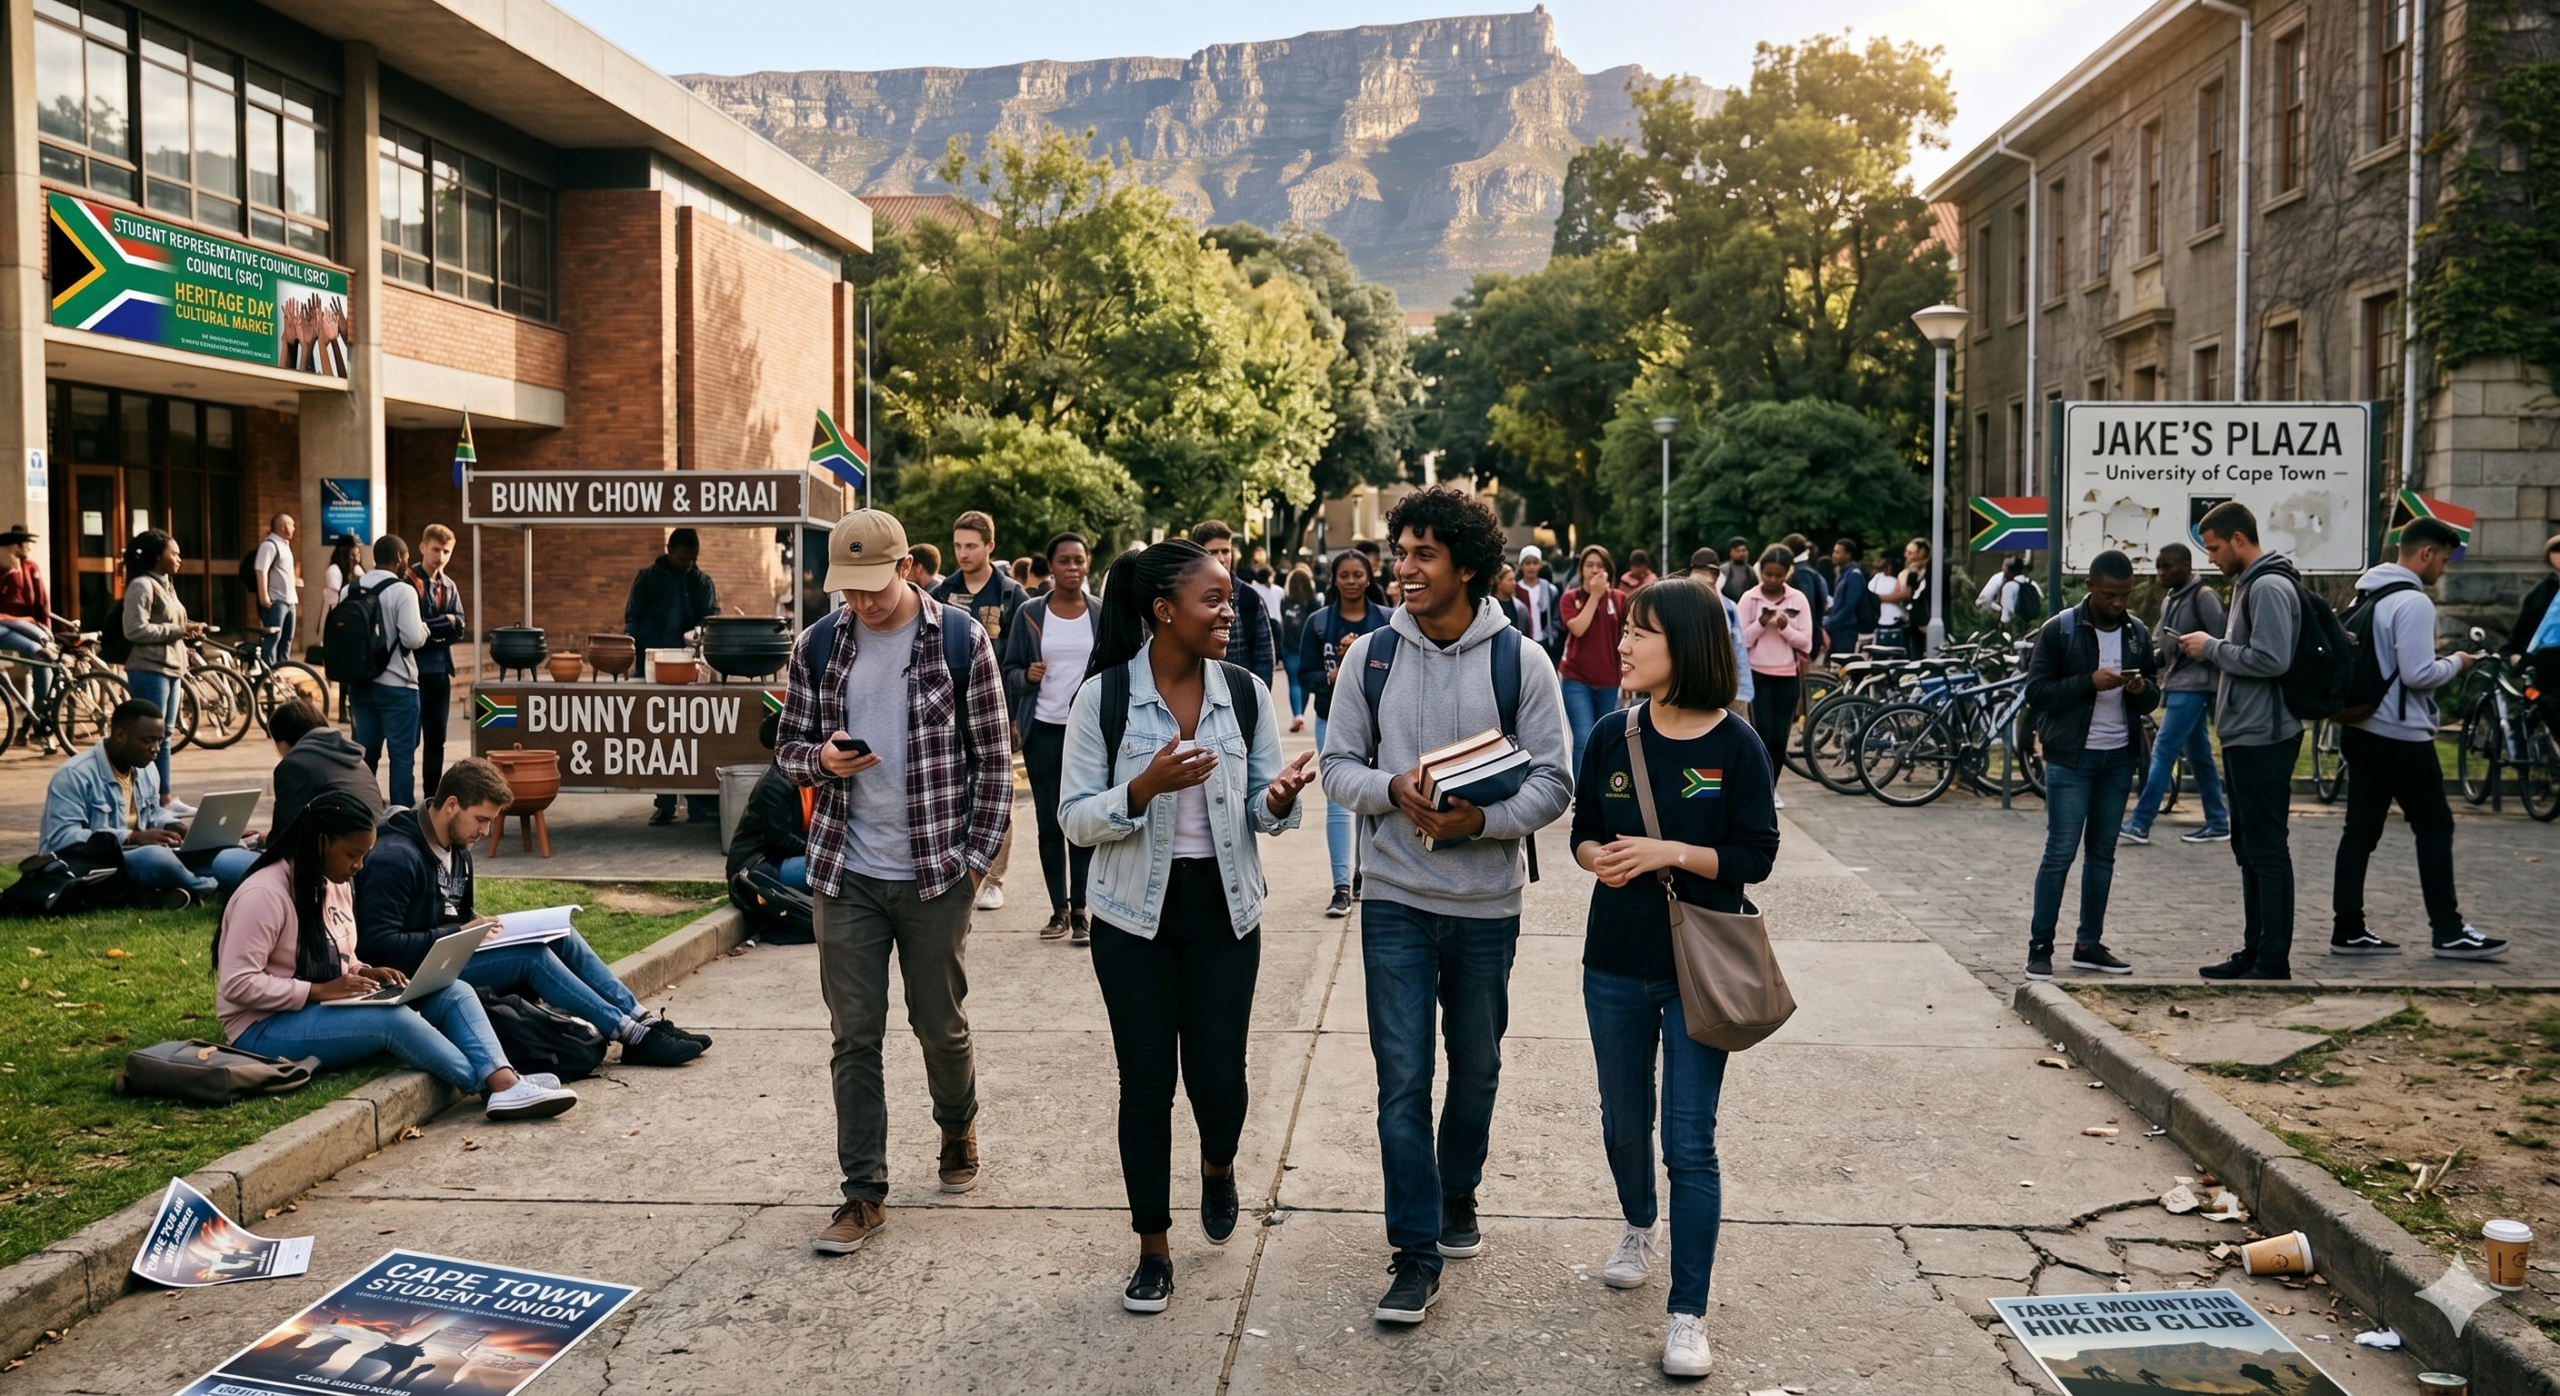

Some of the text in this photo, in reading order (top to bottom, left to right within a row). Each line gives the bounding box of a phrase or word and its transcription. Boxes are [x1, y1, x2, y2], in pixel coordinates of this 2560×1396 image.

[113, 217, 329, 288] STUDENT REPRESENTATIVE COUNCIL (SRC)
[186, 257, 263, 290] COUNCIL (SRC)
[175, 281, 274, 319] HERITAGE DAY
[175, 303, 274, 336] CULTURAL MARKET
[2092, 420, 2342, 456] JAKE'S PLAZA
[2105, 464, 2326, 485] University of Cape Town
[491, 481, 777, 513] BUNNY CHOW & BRAAI
[528, 695, 741, 734] BUNNY CHOW
[570, 738, 698, 776] & BRAAI
[366, 1278, 493, 1307] STUDENT
[493, 1298, 586, 1322] UNION
[386, 1262, 604, 1308] CAPE TOWN
[2008, 1296, 2239, 1317] TABLE MOUNTAIN
[2022, 1311, 2255, 1337] HIKING CLUB
